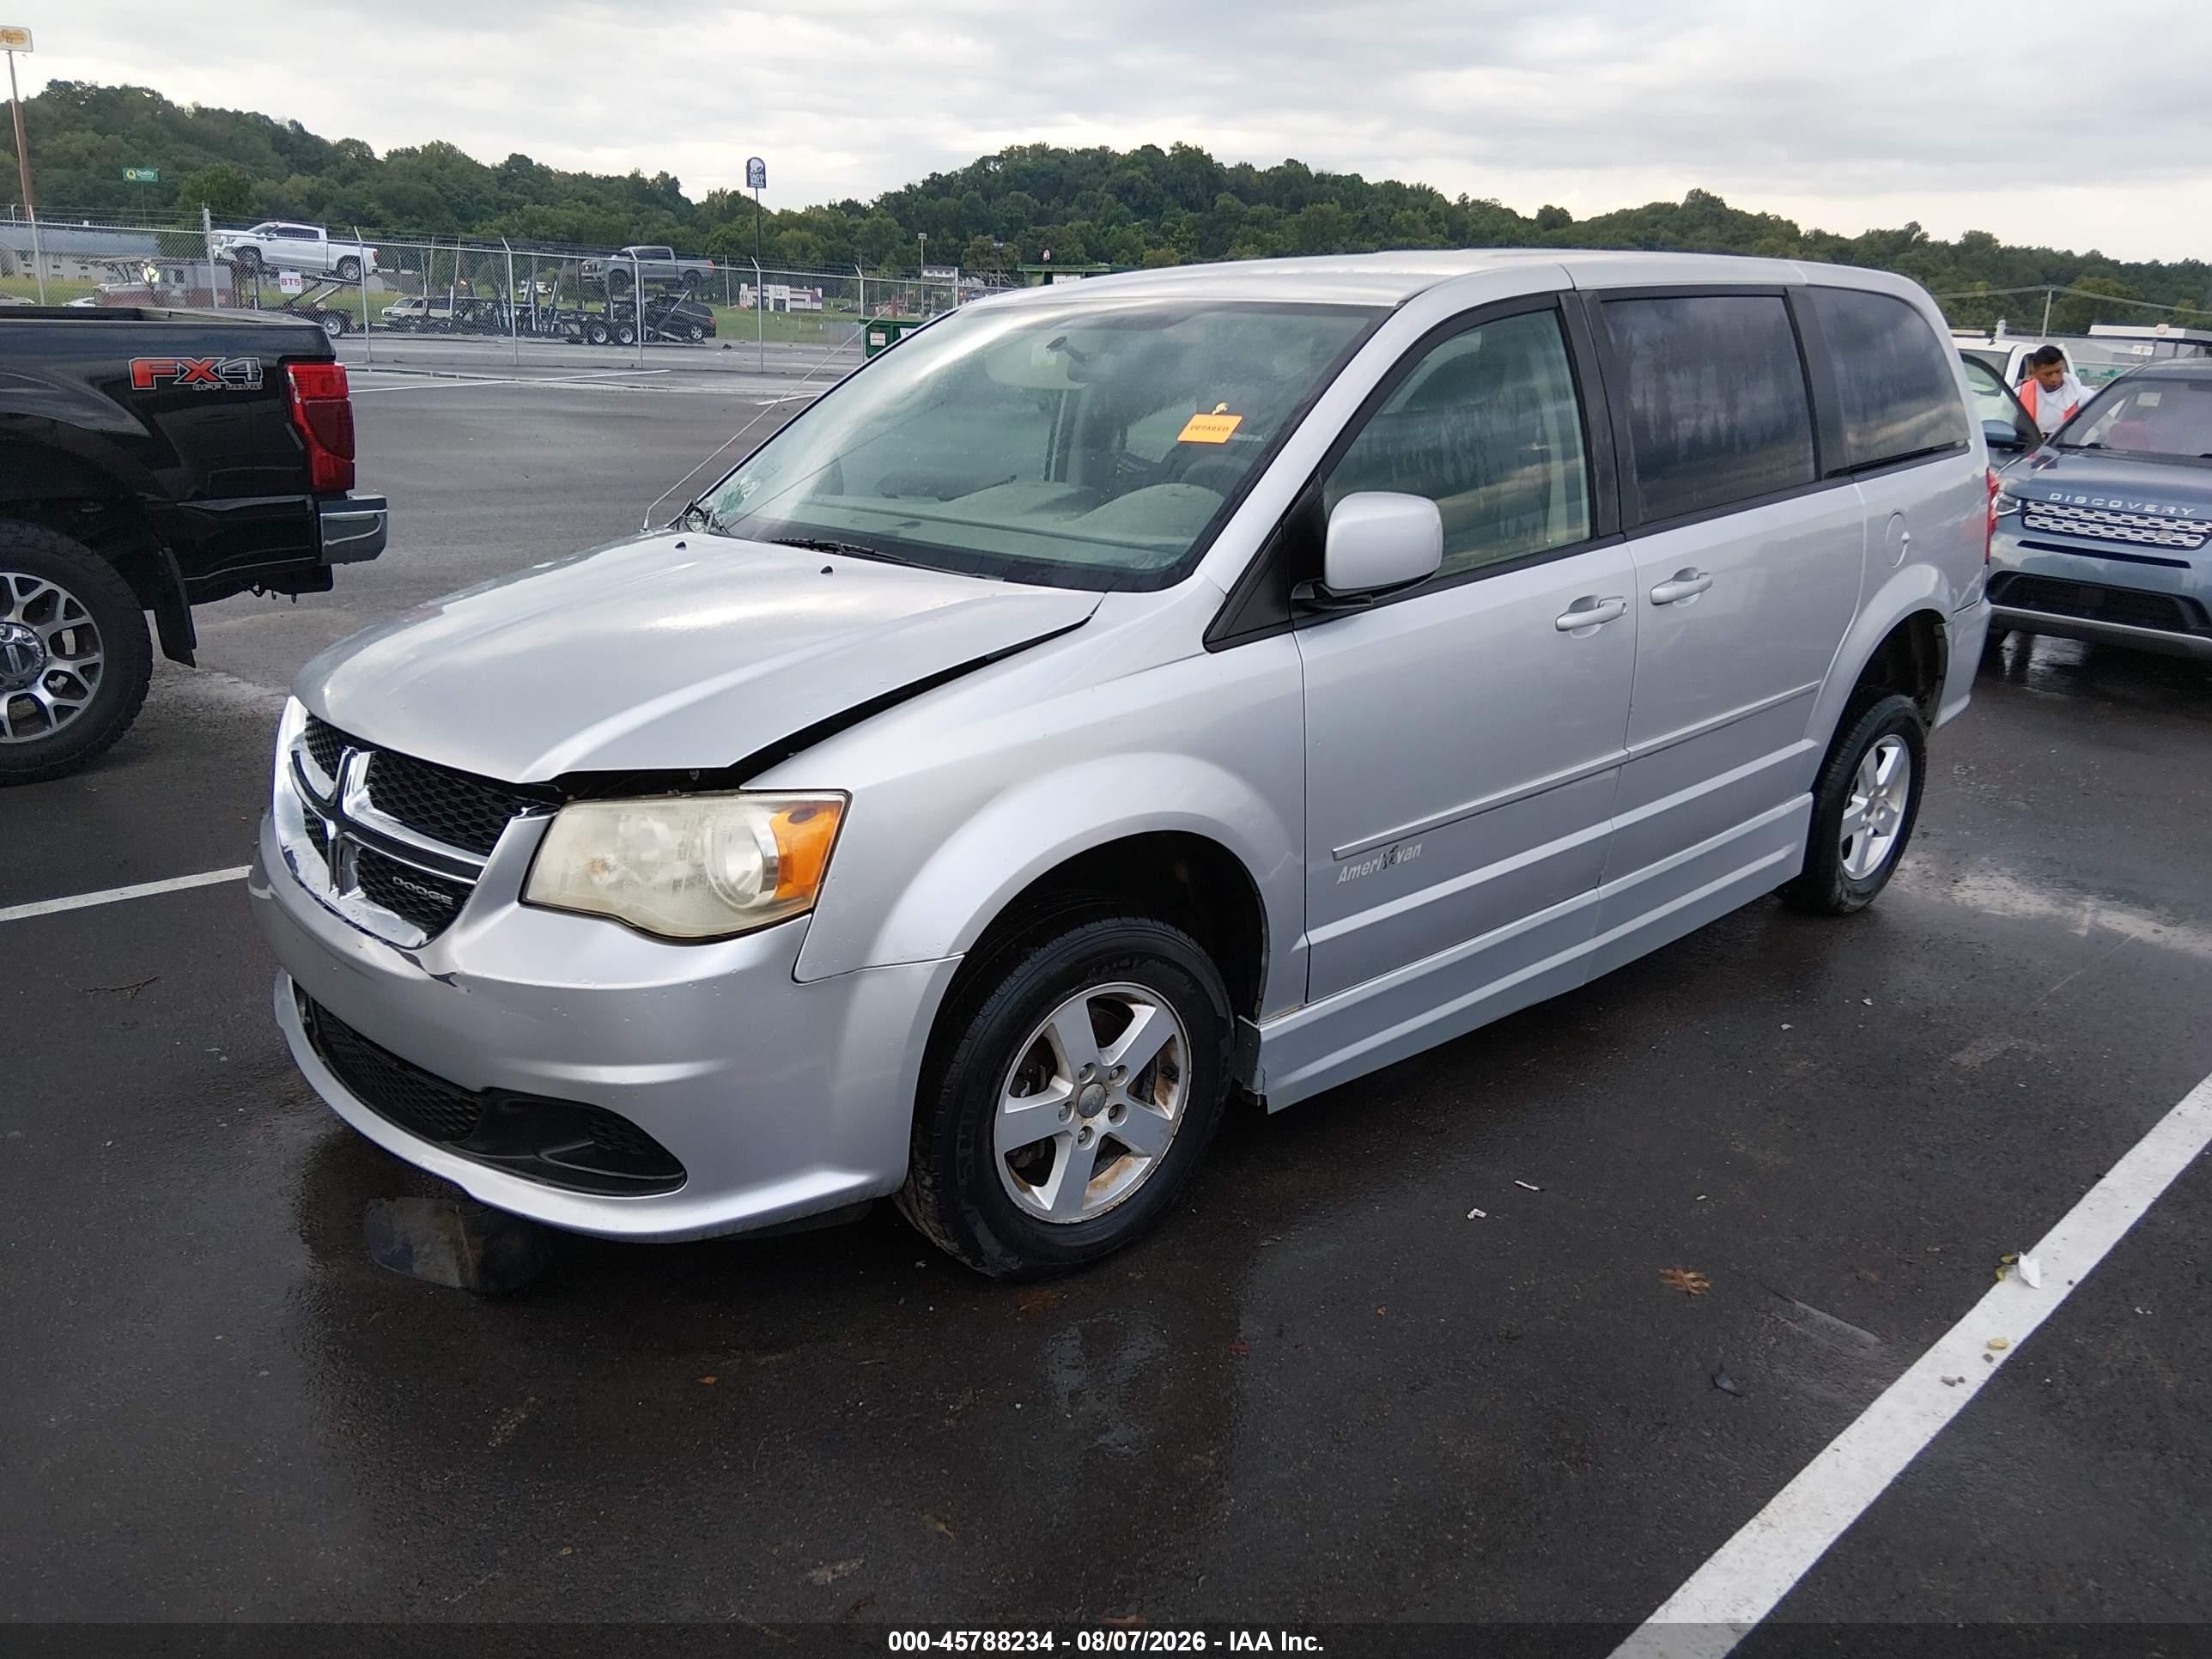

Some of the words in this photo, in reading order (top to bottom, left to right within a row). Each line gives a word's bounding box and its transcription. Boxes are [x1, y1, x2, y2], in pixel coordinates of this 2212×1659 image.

[128, 356, 264, 390] FX4
[2049, 493, 2196, 516] DISCOVERY
[392, 876, 454, 906] DODGE
